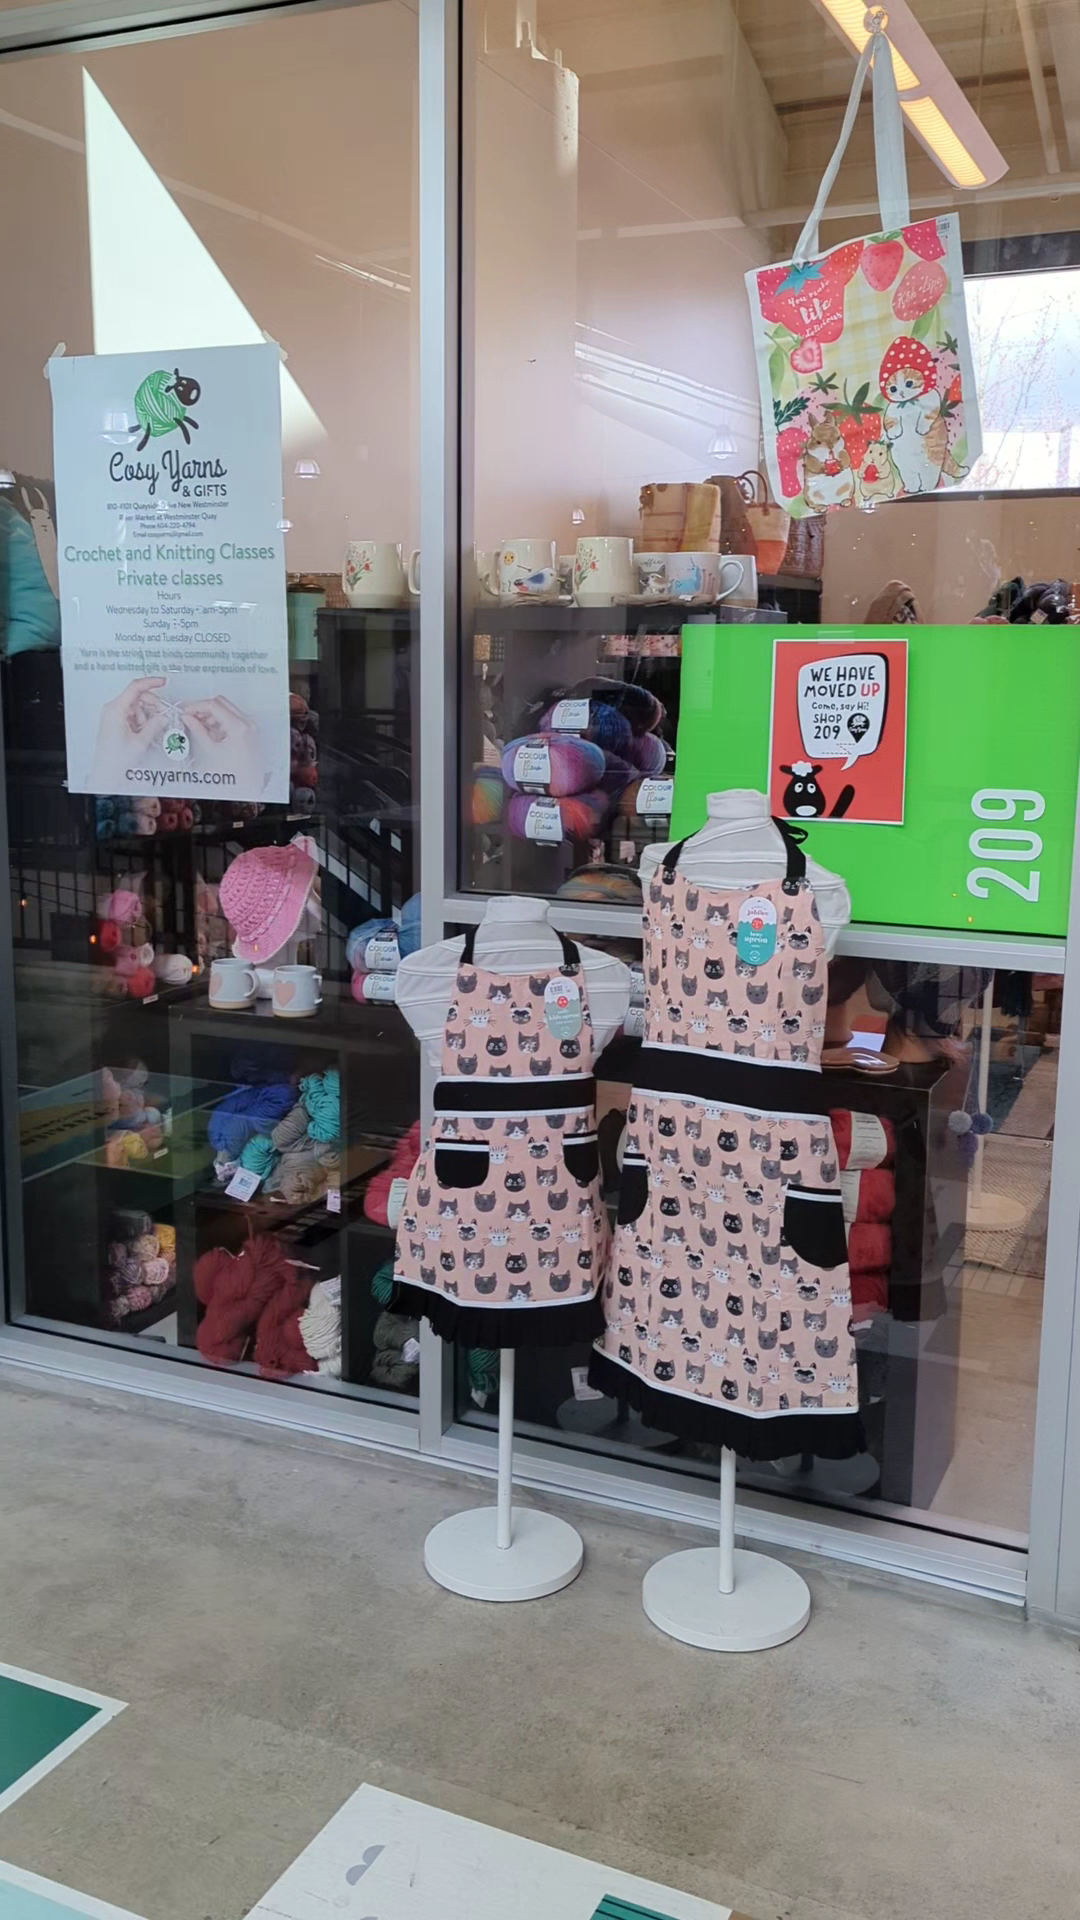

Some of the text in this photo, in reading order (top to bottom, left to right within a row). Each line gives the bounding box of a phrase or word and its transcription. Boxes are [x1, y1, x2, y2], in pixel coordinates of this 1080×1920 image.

[800, 298, 832, 324] life
[109, 449, 228, 495] Cosy Yarns
[182, 484, 227, 497] & GIFTS
[201, 512, 217, 520] Quay
[64, 542, 275, 564] Crochet and Knitting Classes
[117, 568, 223, 586] Private classes
[157, 590, 181, 600] Hours
[106, 605, 149, 616] Wednesday
[150, 606, 159, 614] to
[160, 604, 194, 616] Saturday
[143, 618, 170, 630] Sunday
[115, 632, 231, 644] Monday and Tuesday CLOSED
[184, 649, 230, 660] community
[74, 662, 89, 671] and
[202, 663, 246, 674] expression
[247, 663, 257, 673] of
[810, 665, 876, 682] WE HAVE
[804, 682, 881, 698] MOVED UP
[811, 701, 869, 711] Come, say Hi!
[813, 713, 843, 724] SHOP
[813, 725, 841, 740] 209
[518, 751, 548, 760] COLOUR
[125, 768, 236, 786] cosyyarns.com
[529, 810, 559, 820] COLOUR
[966, 788, 1046, 903] 209
